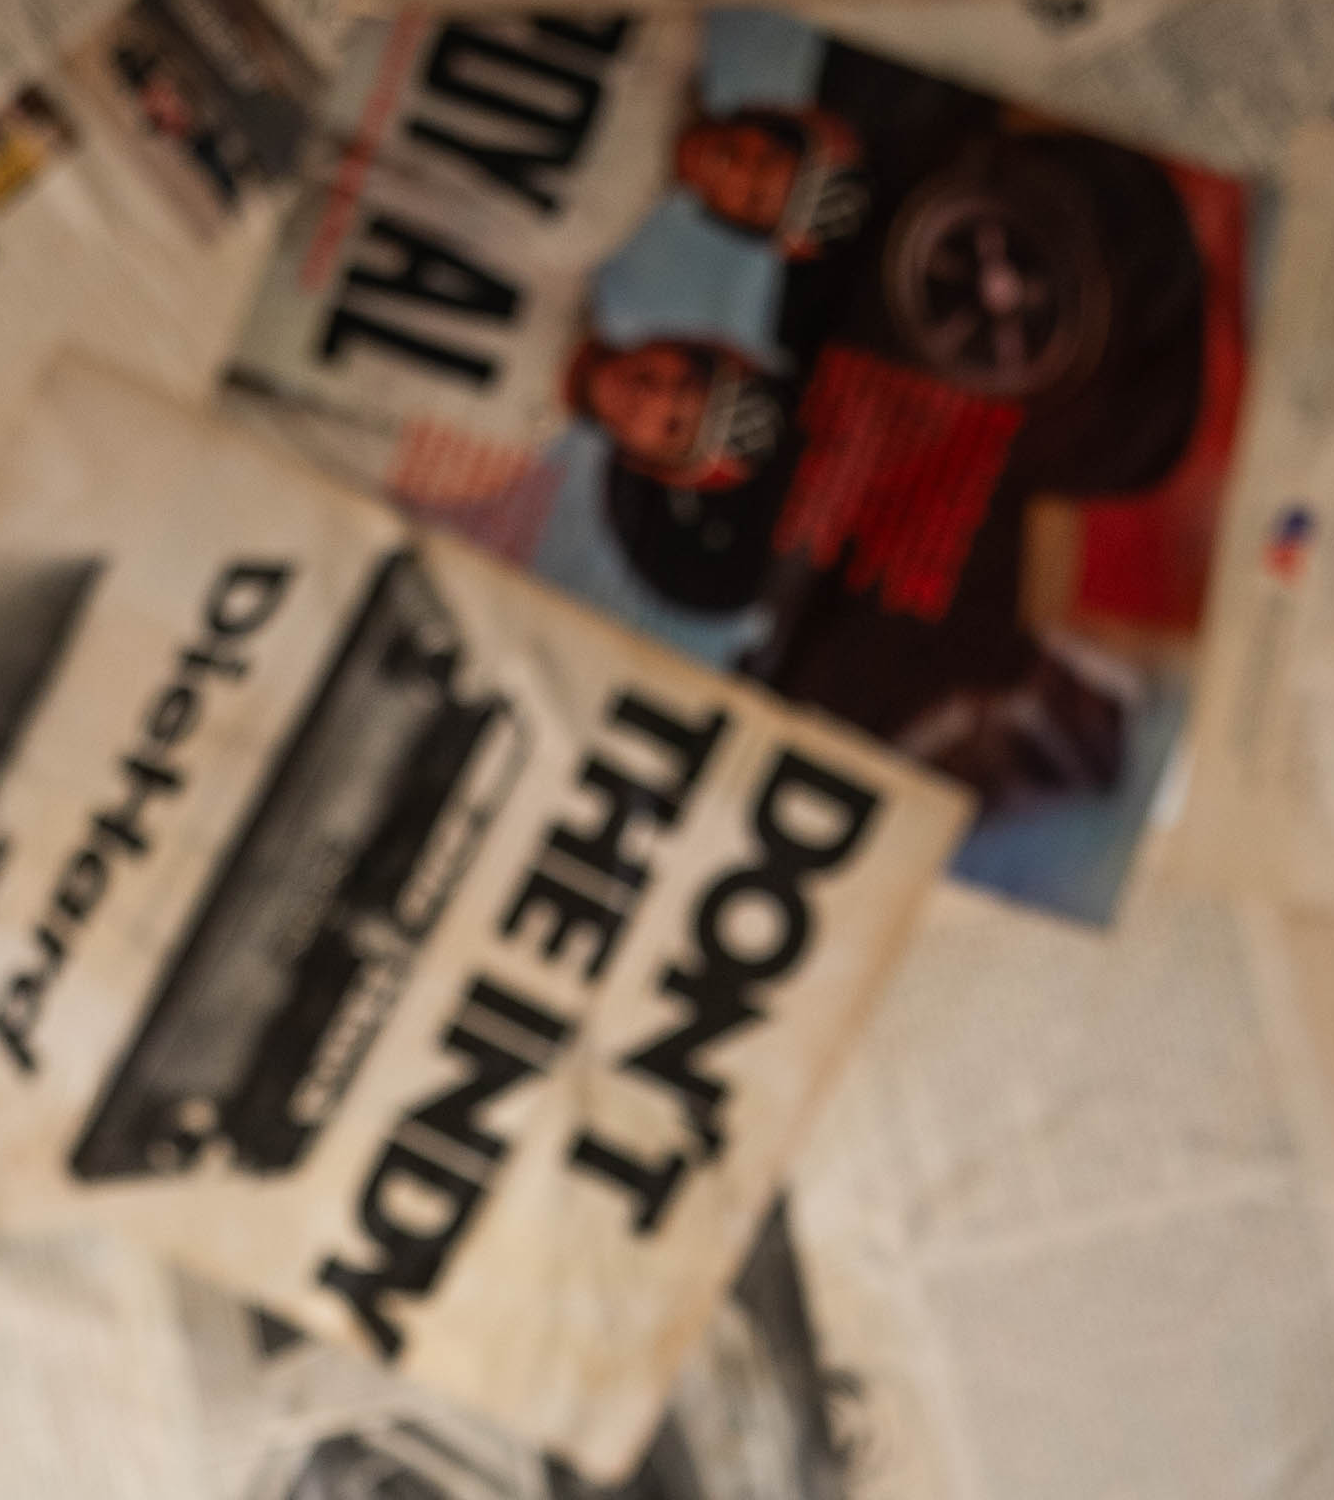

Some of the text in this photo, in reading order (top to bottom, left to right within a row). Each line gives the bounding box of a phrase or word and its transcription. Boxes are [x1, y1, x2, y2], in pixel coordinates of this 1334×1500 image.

[495, 687, 731, 983] THE
[567, 747, 882, 1238] DON'T
[315, 972, 579, 1366] INDY
